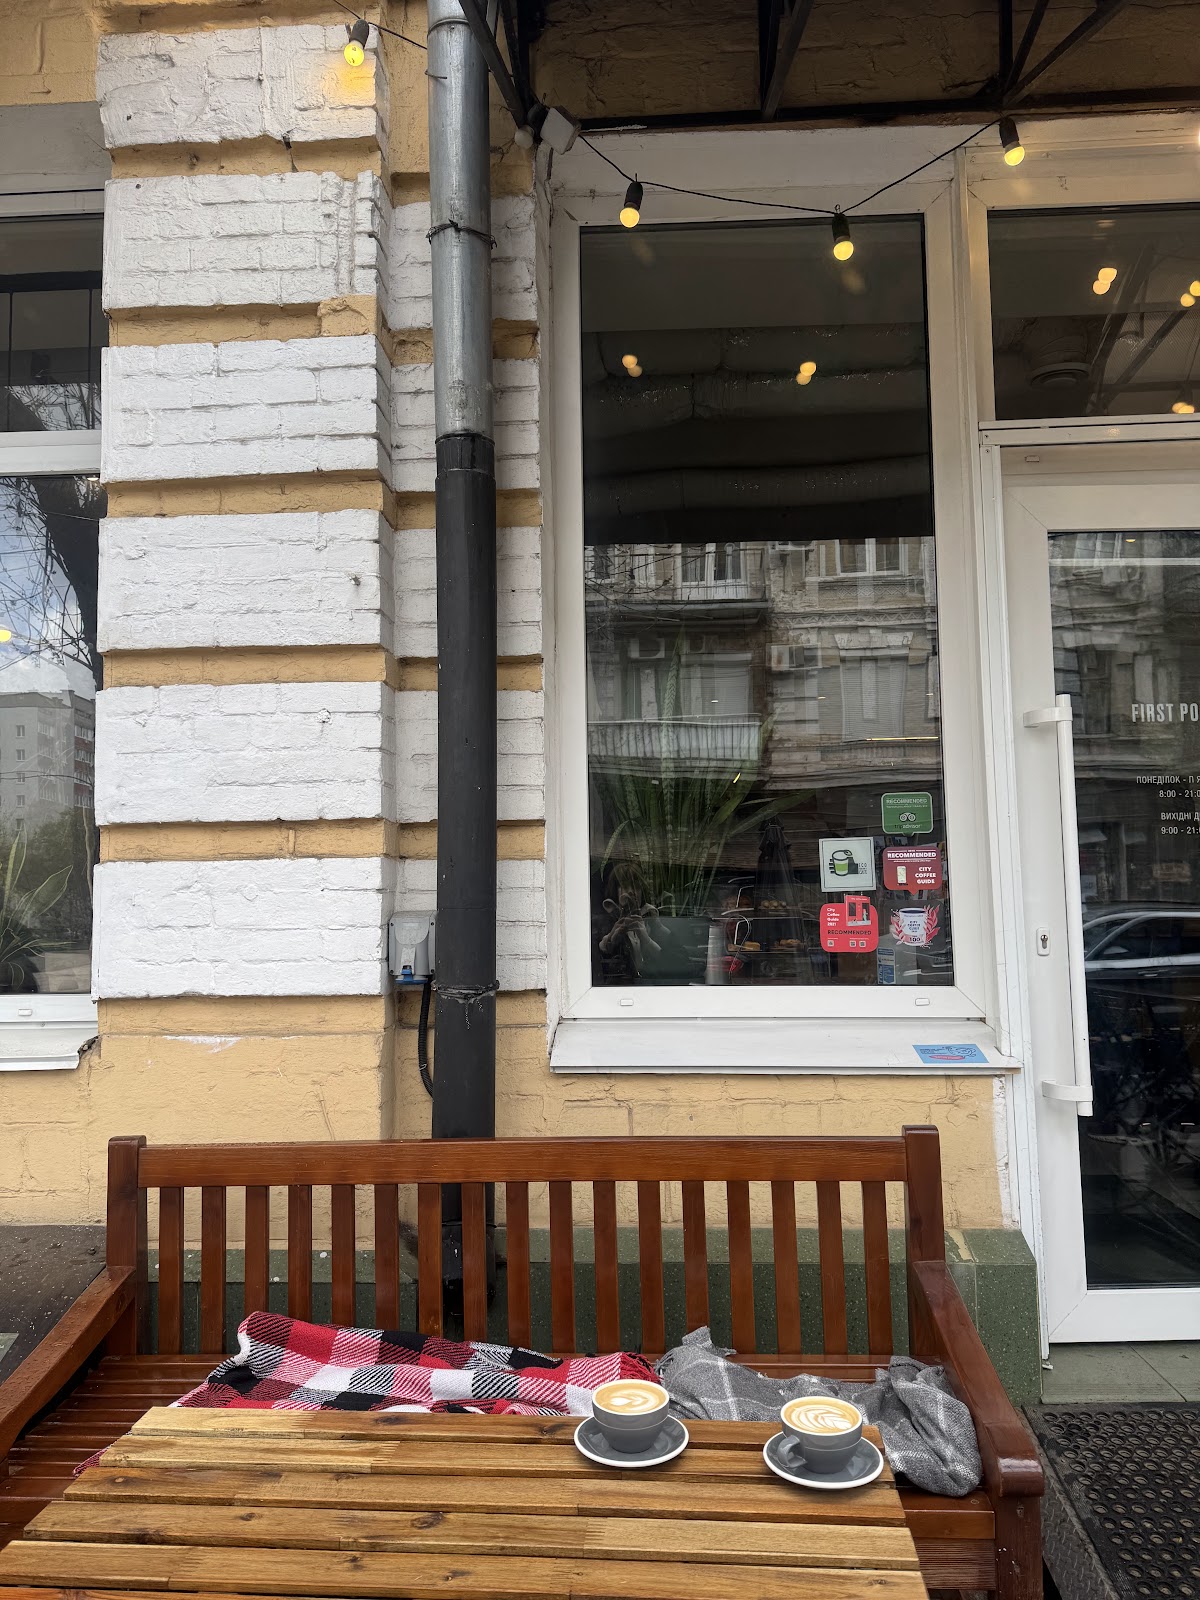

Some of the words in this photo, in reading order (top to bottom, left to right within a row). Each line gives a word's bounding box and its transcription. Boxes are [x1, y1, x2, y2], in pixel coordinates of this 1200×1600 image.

[1131, 703, 1174, 722] FIRST
[1179, 702, 1199, 722] PO
[1159, 789, 1177, 798] 8:00
[1161, 812, 1192, 821] ВИХІДНІ
[1161, 826, 1179, 835] 9:00
[1186, 826, 1200, 835] 21:
